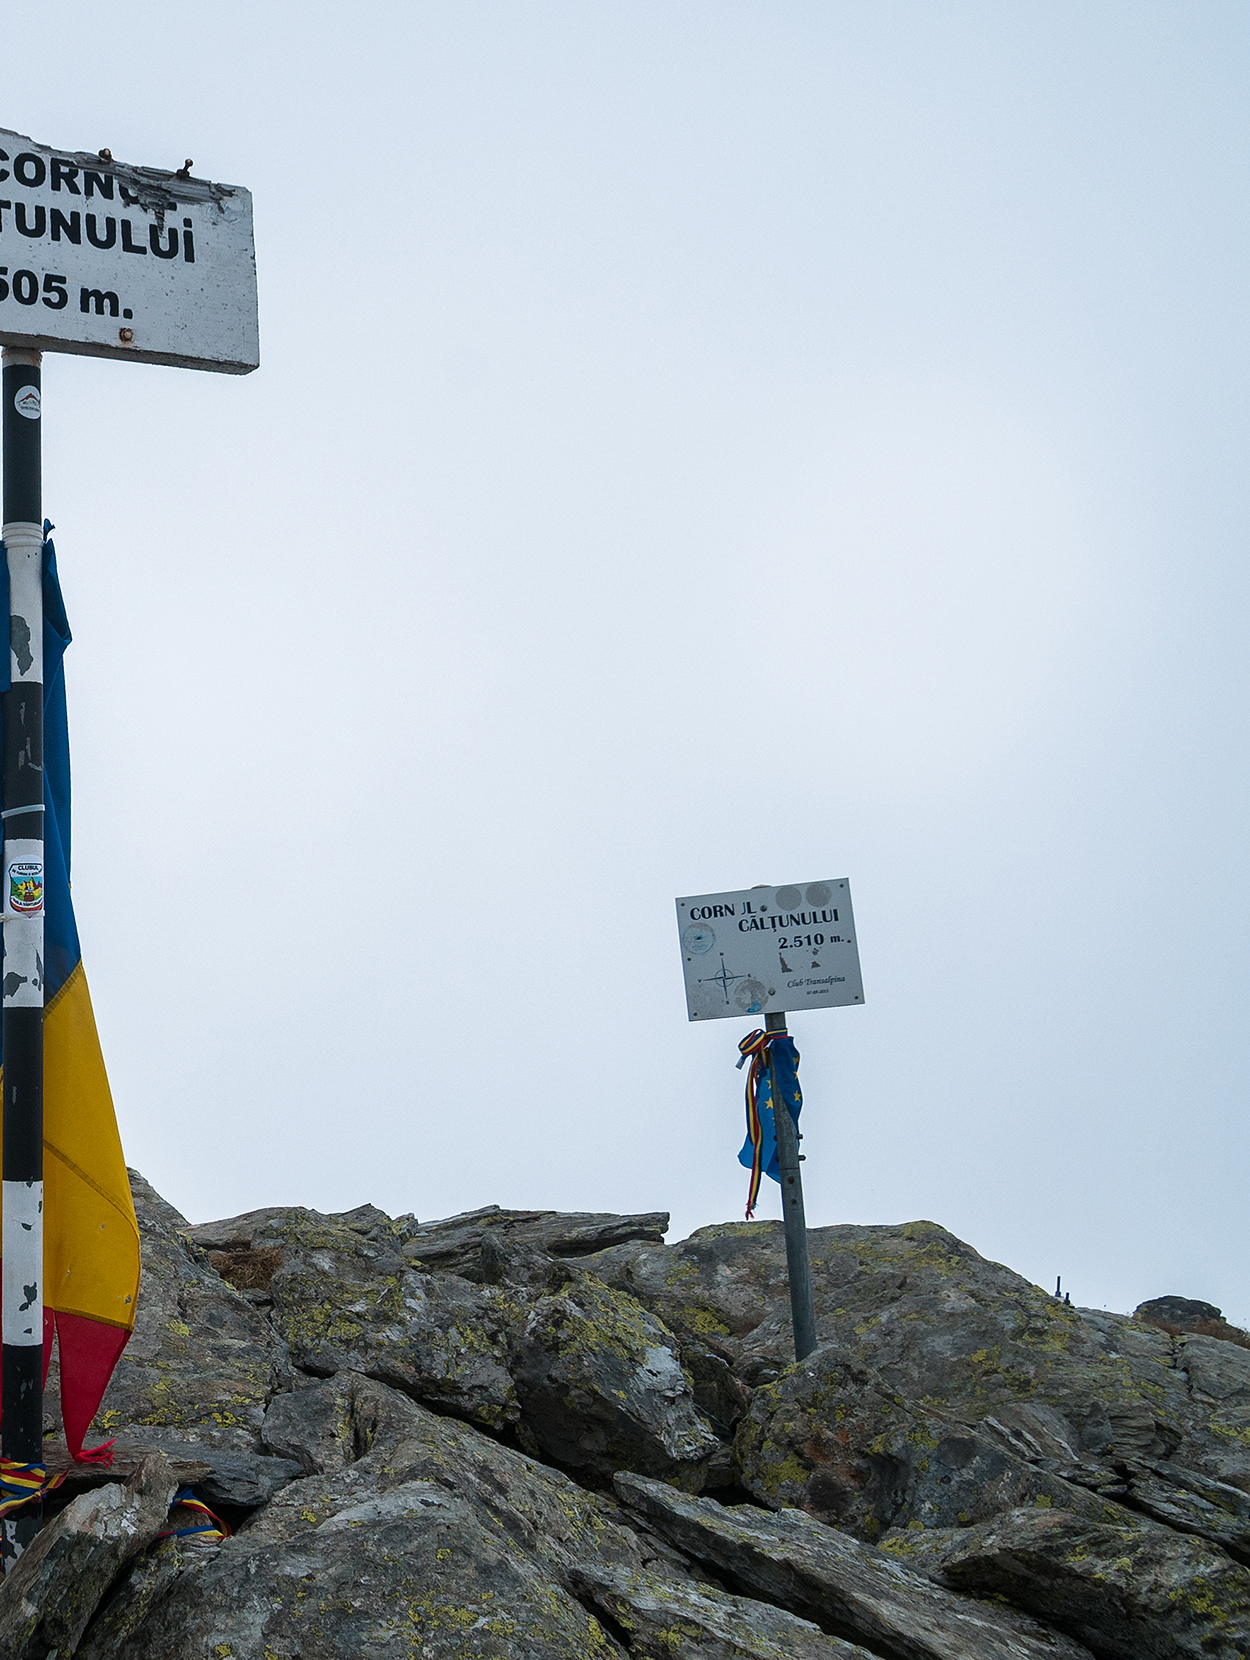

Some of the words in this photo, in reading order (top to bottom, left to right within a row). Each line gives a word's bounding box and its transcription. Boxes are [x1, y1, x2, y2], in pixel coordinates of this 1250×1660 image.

[79, 287, 134, 319] m.
[778, 933, 825, 950] 2.510
[830, 935, 845, 943] m.
[787, 979, 804, 989] Club
[804, 975, 846, 986] Transalpina
